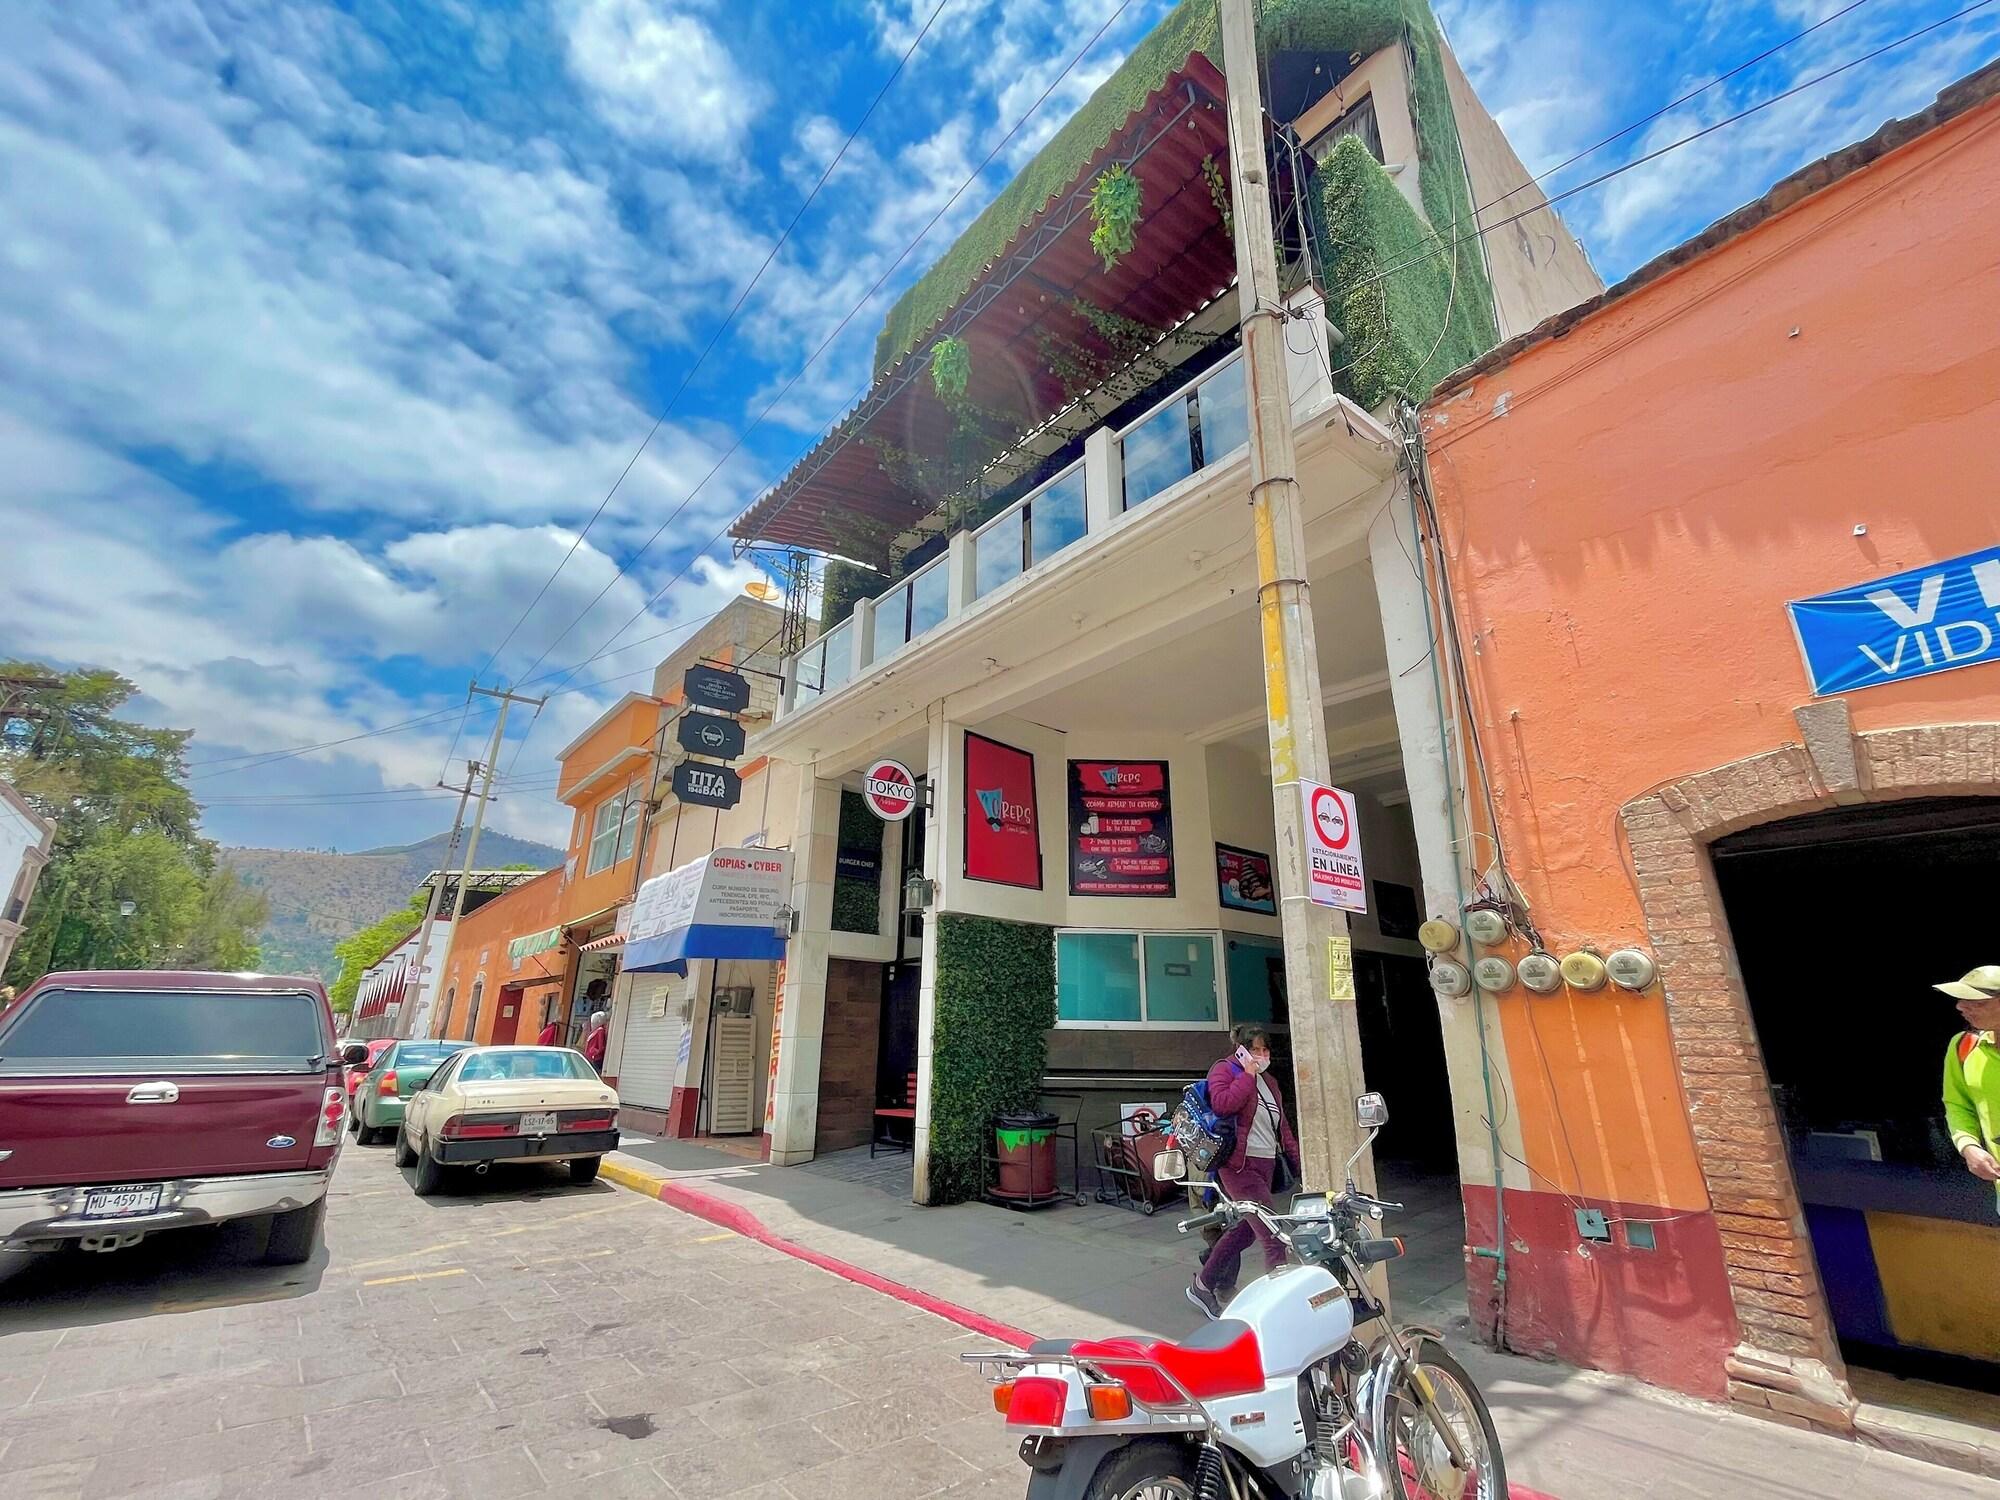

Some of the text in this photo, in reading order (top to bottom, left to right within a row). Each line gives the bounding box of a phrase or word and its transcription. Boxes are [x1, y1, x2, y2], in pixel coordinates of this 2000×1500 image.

[1858, 612, 2000, 675] VID
[690, 770, 725, 789] TITA
[868, 778, 914, 799] TOKYO
[703, 786, 724, 798] BAR
[1312, 847, 1357, 863] ESTACIONAMIENTO
[714, 857, 782, 872] COPIAS CYBER
[1313, 857, 1327, 871] EN
[1330, 859, 1360, 878] LÍNEA
[1341, 877, 1361, 888] MINUTOS
[766, 960, 787, 1121] APELERIA
[89, 1191, 159, 1209] MU-4591-F
